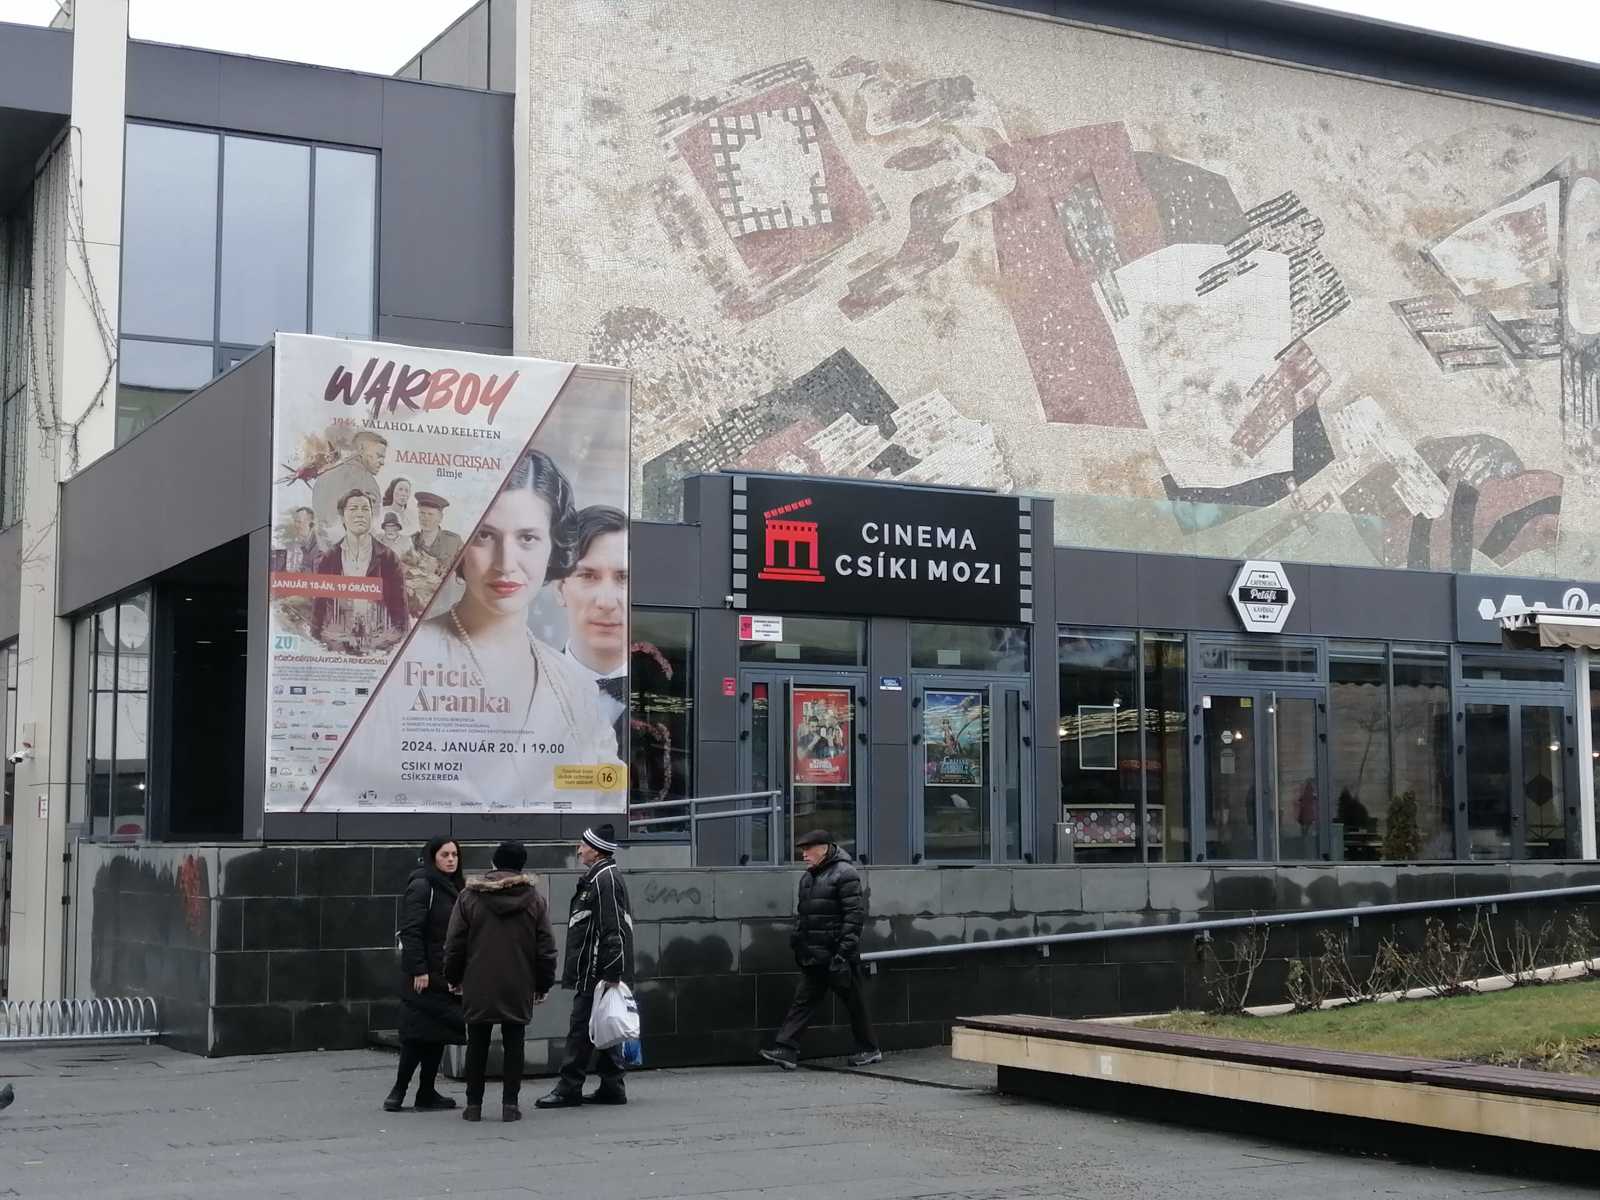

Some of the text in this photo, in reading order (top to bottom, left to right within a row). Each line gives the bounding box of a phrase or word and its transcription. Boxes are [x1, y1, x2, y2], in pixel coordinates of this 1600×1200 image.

[324, 357, 519, 425] WARBOY
[362, 418, 415, 433] VALAHOL
[417, 424, 425, 434] A
[427, 425, 449, 436] VAD
[450, 427, 501, 440] KELETEN
[396, 449, 452, 466] MARIAN
[436, 467, 463, 480] filmje
[861, 521, 977, 551] CINEMA
[834, 551, 1002, 585] CSÍKI MOZI
[409, 687, 511, 713] Aranka
[401, 741, 437, 752] 2024.
[441, 740, 495, 753] JANUÁR
[499, 742, 518, 753] 20.
[532, 743, 565, 754] 19.00
[434, 762, 463, 771] MOZI
[602, 772, 613, 782] 16
